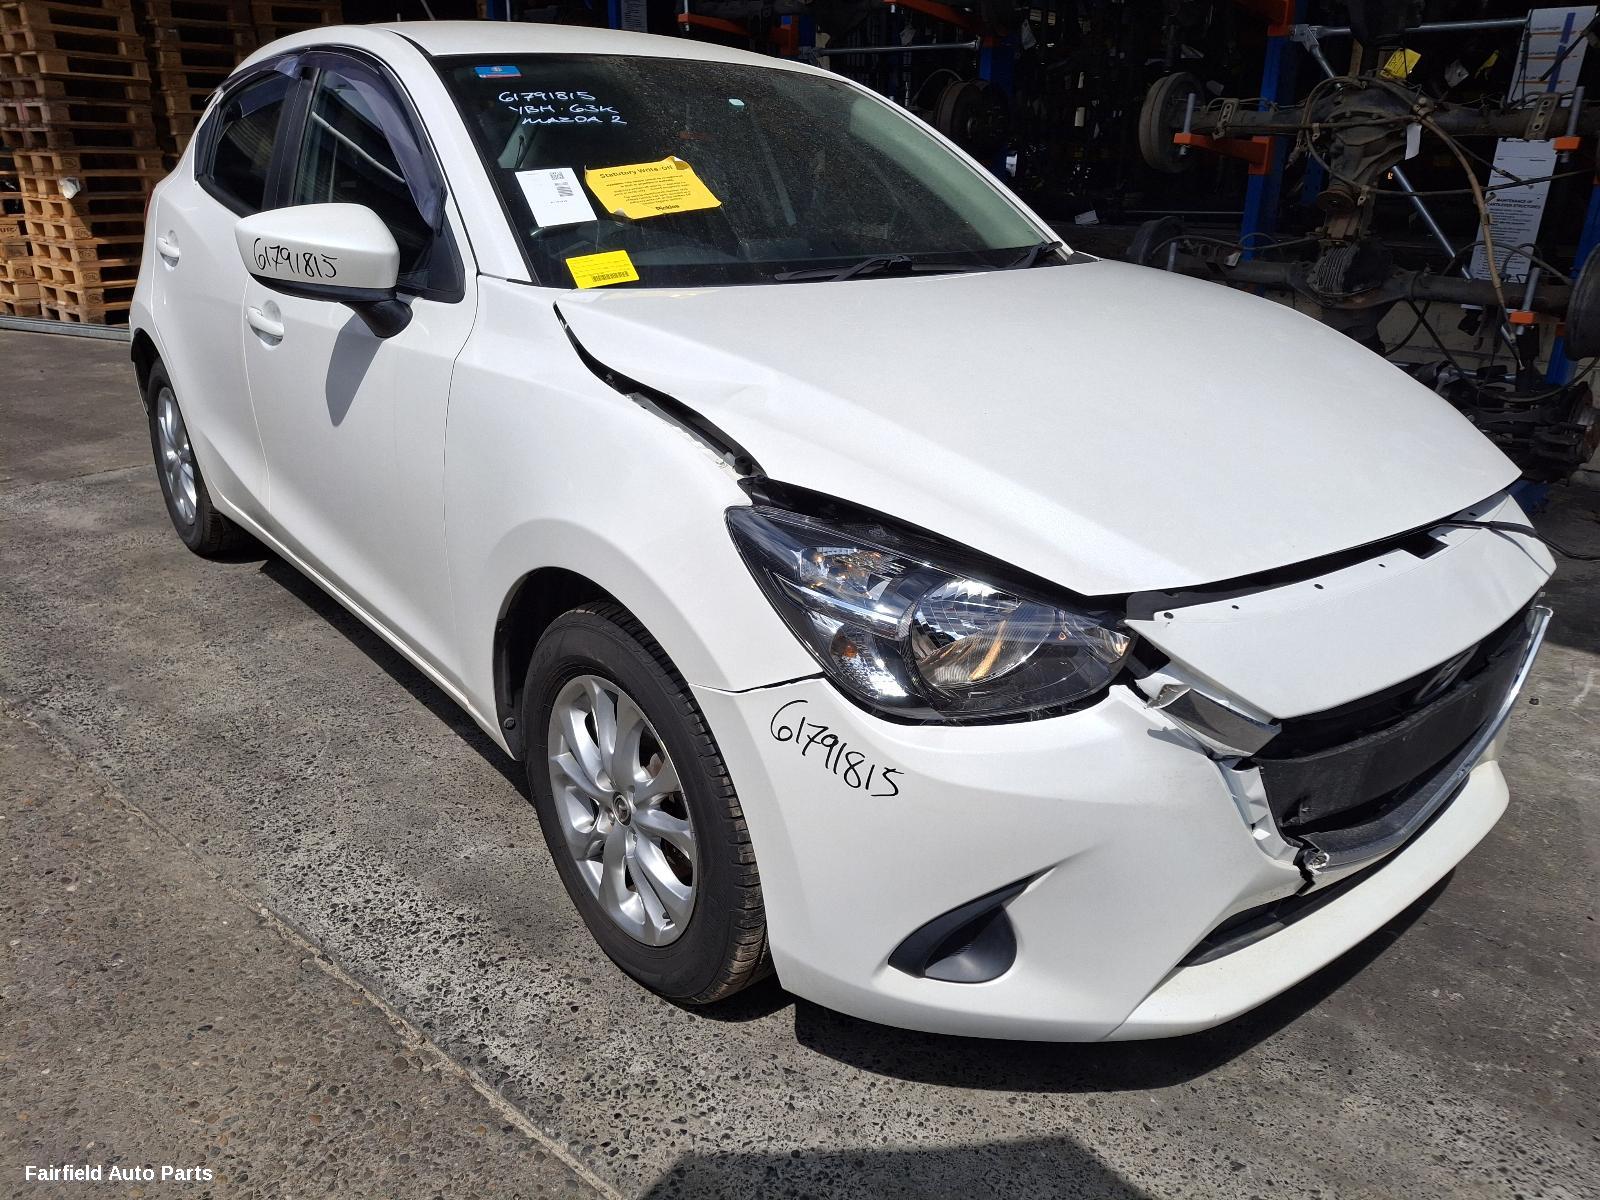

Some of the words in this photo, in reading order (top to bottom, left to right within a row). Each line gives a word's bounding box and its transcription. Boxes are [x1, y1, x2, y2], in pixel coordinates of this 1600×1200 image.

[498, 91, 597, 102] 61791815
[611, 116, 628, 125] 2
[599, 169, 637, 179] Statutory
[253, 238, 338, 279] 61791815
[770, 699, 905, 797] 61791815
